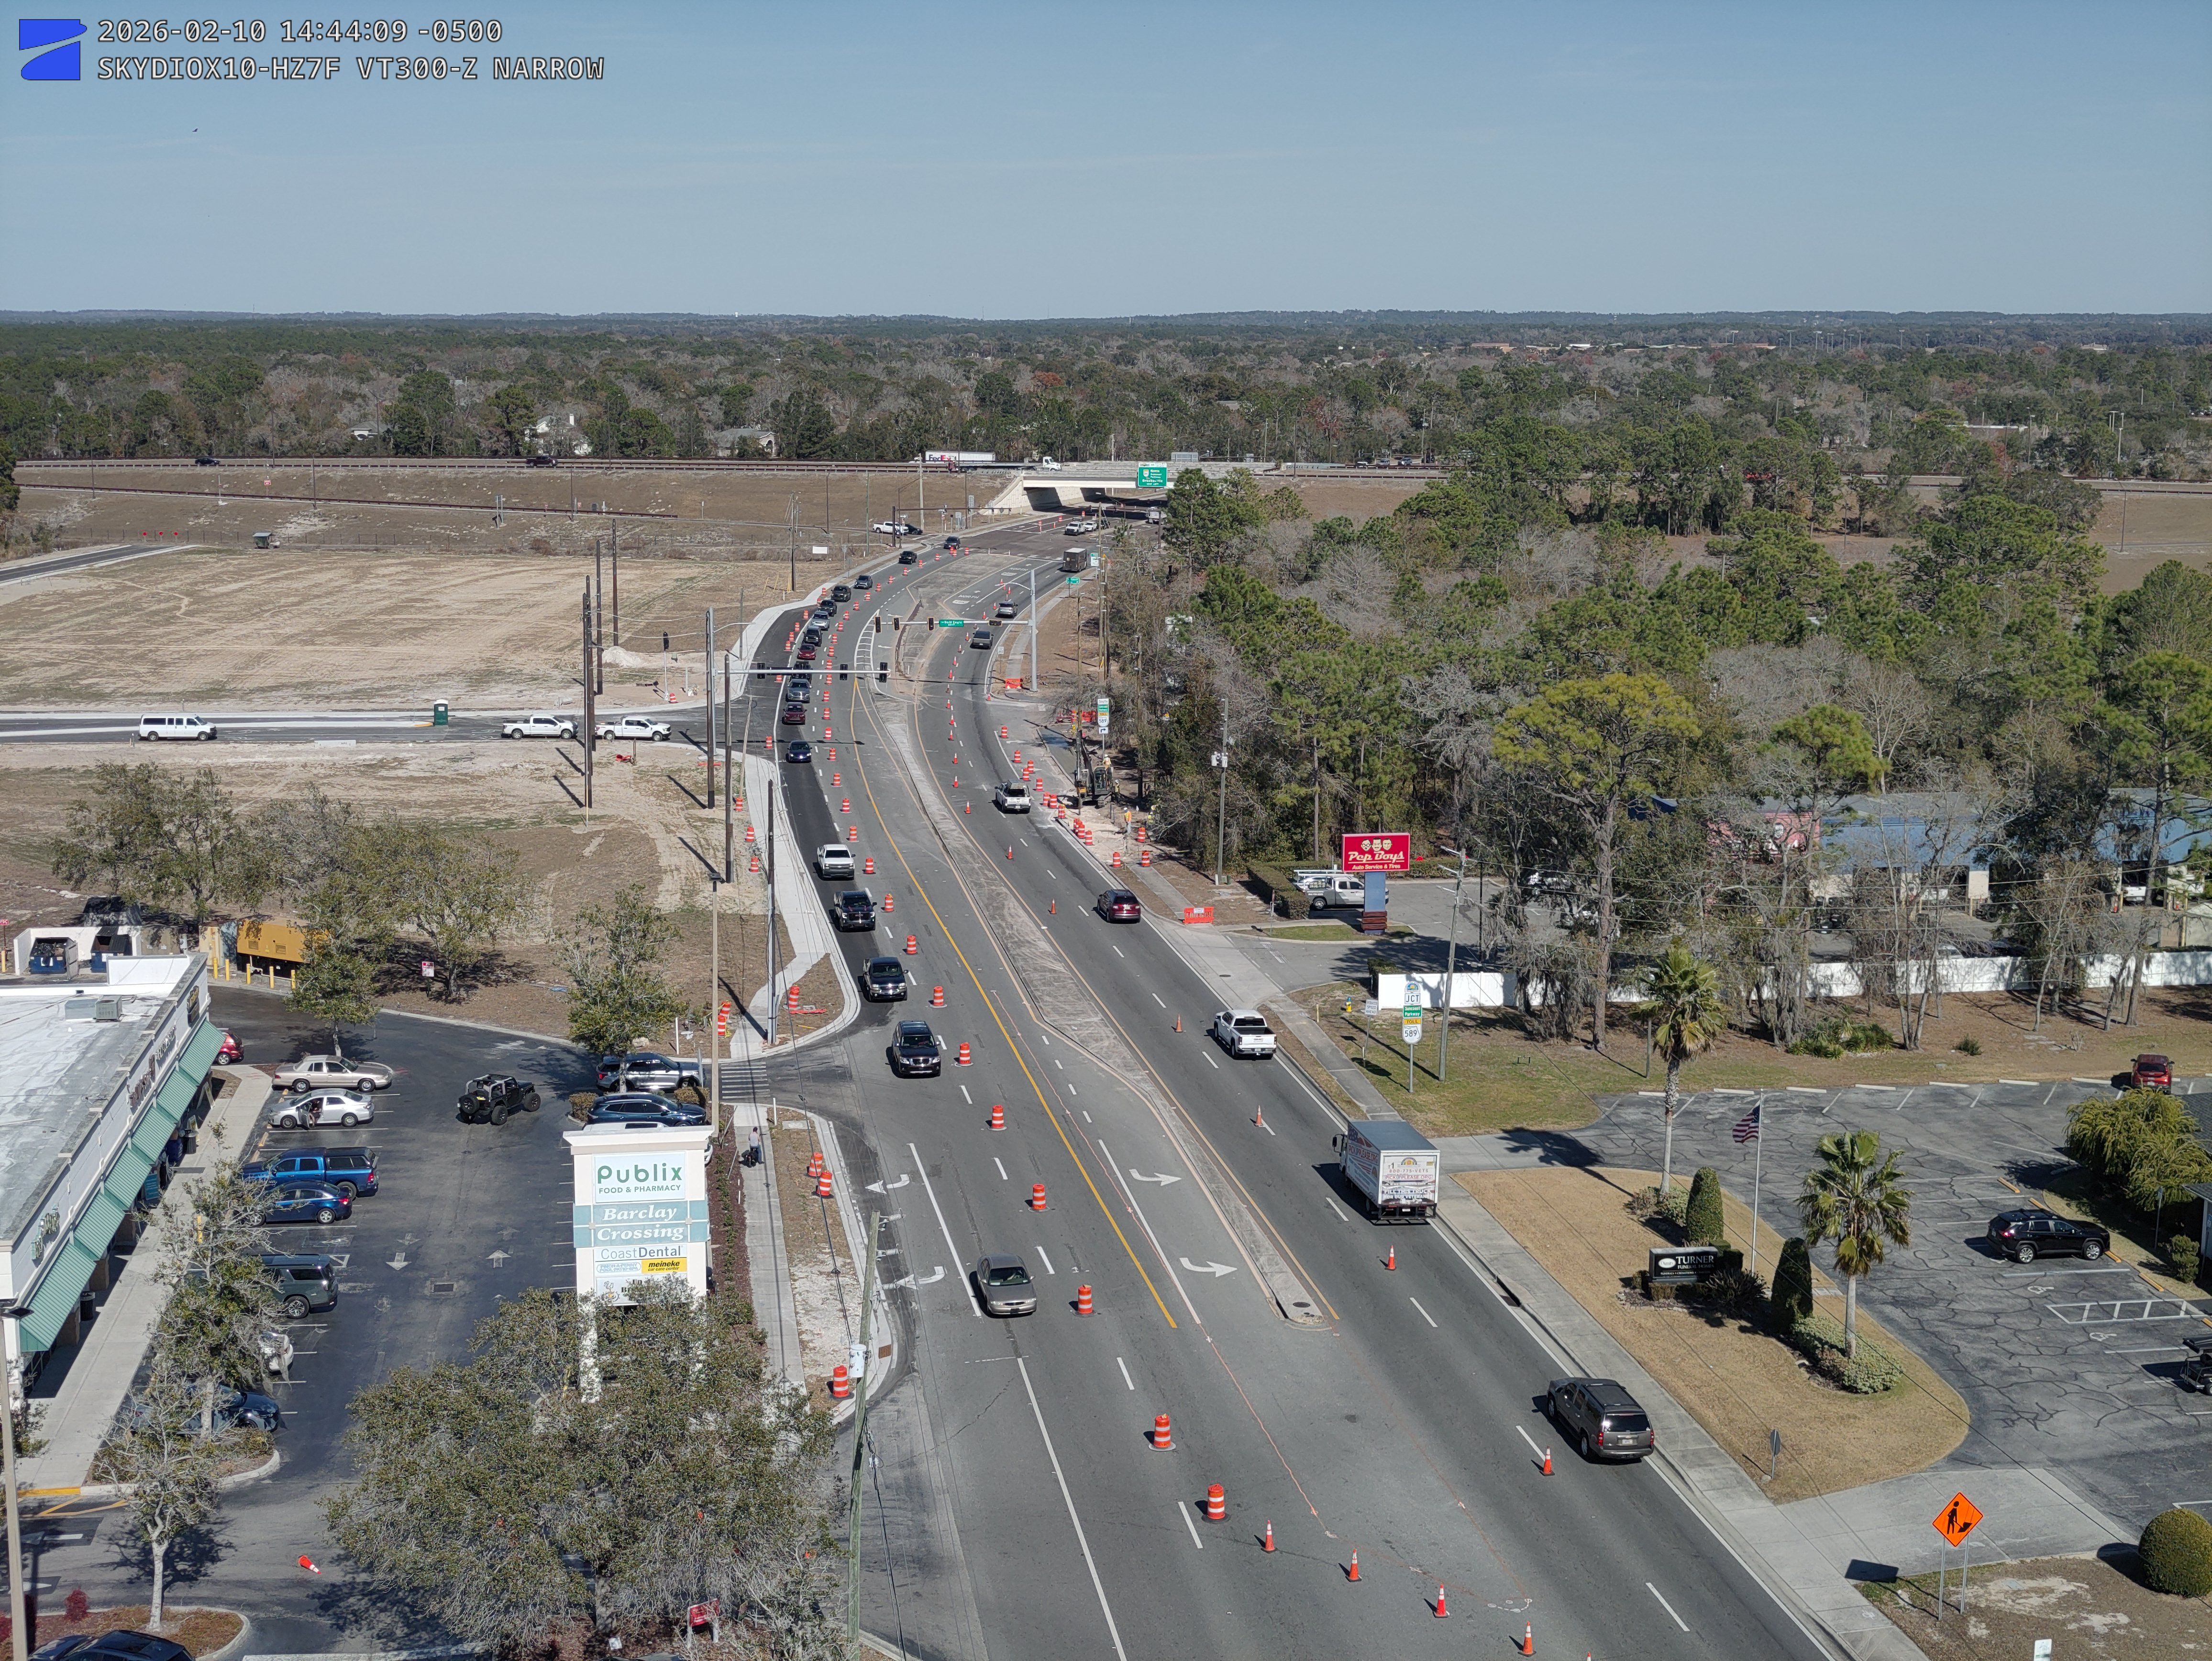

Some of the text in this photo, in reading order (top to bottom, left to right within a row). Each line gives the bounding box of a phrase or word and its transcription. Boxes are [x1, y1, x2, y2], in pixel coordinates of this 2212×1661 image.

[1348, 851, 1405, 864] Pep Boys
[1405, 995, 1419, 1003] JCT
[597, 1163, 683, 1184] Publix
[634, 1184, 681, 1193] PHARMACY
[602, 1205, 677, 1221] Barclay
[597, 1224, 685, 1241] Crossing
[1675, 1255, 1714, 1264] TURNER
